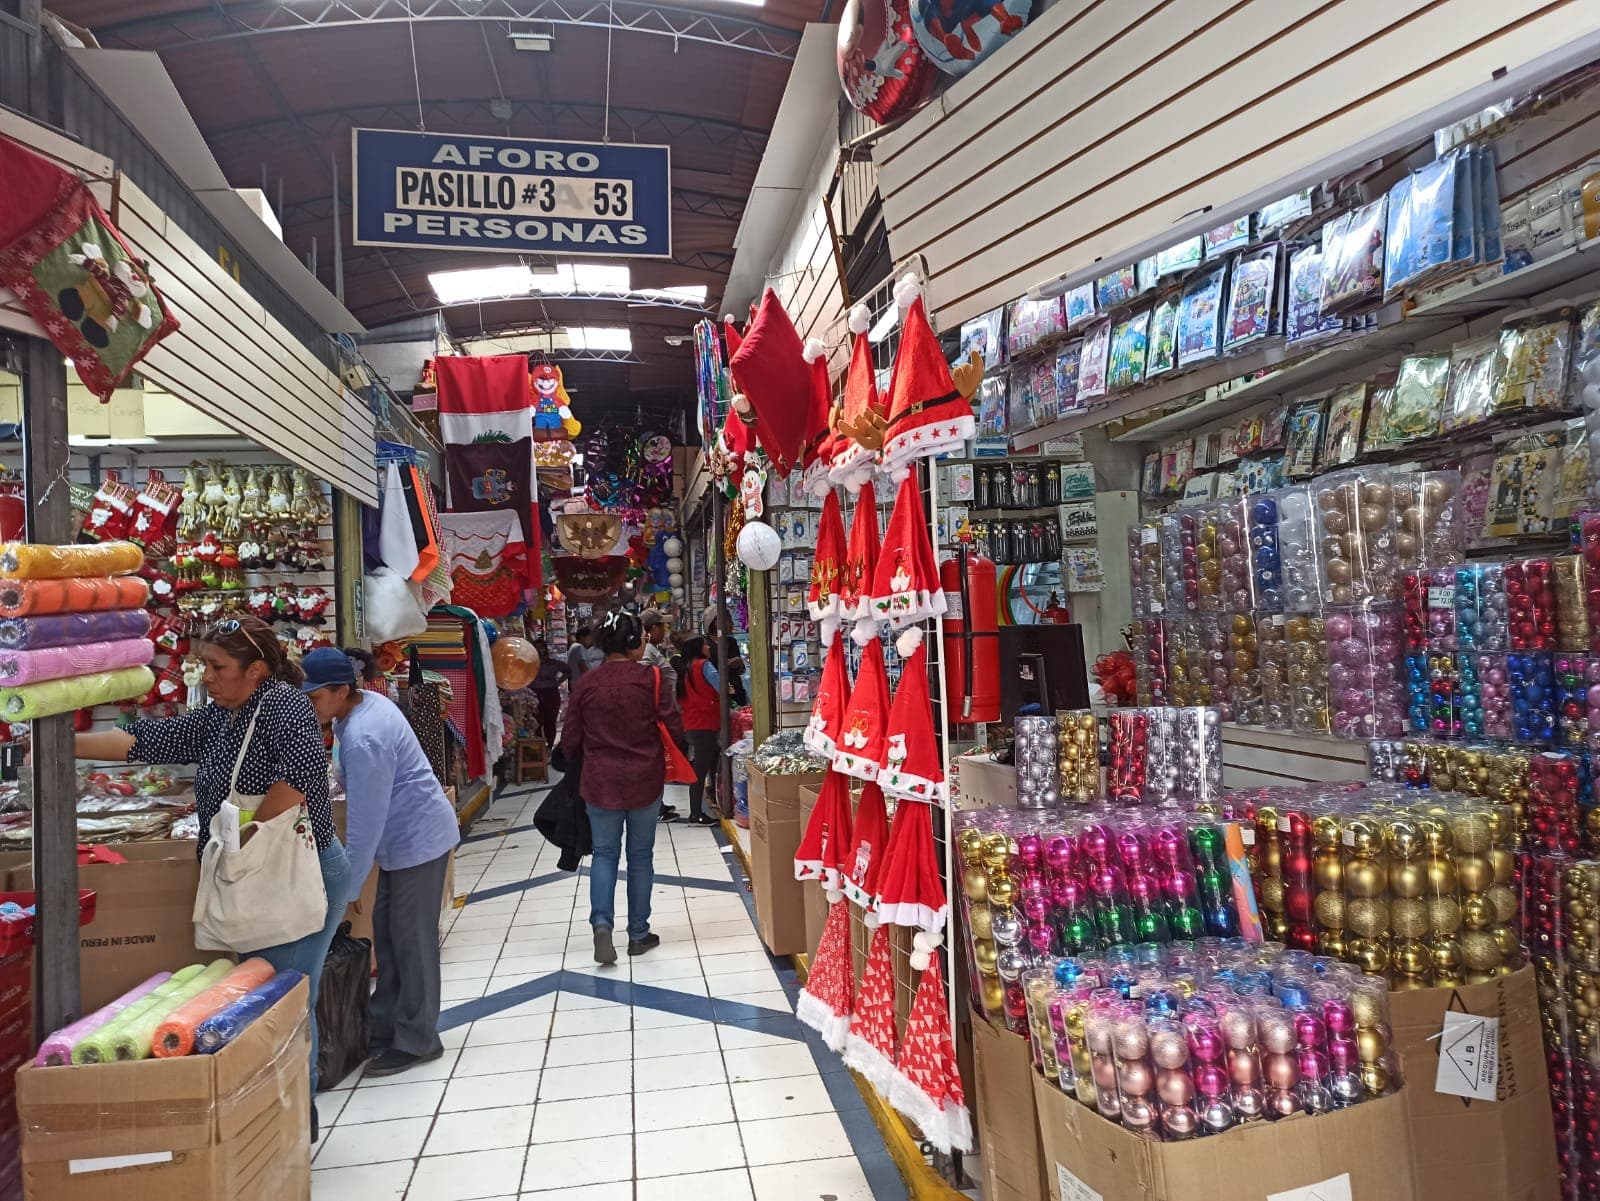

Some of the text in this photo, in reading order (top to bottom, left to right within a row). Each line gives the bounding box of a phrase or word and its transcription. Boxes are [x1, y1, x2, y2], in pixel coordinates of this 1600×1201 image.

[432, 144, 600, 172] AFORO
[400, 170, 516, 211] PASILLO
[593, 182, 628, 216] 53
[383, 212, 648, 245] PERSONAS
[81, 934, 156, 948] MADE IN PERU
